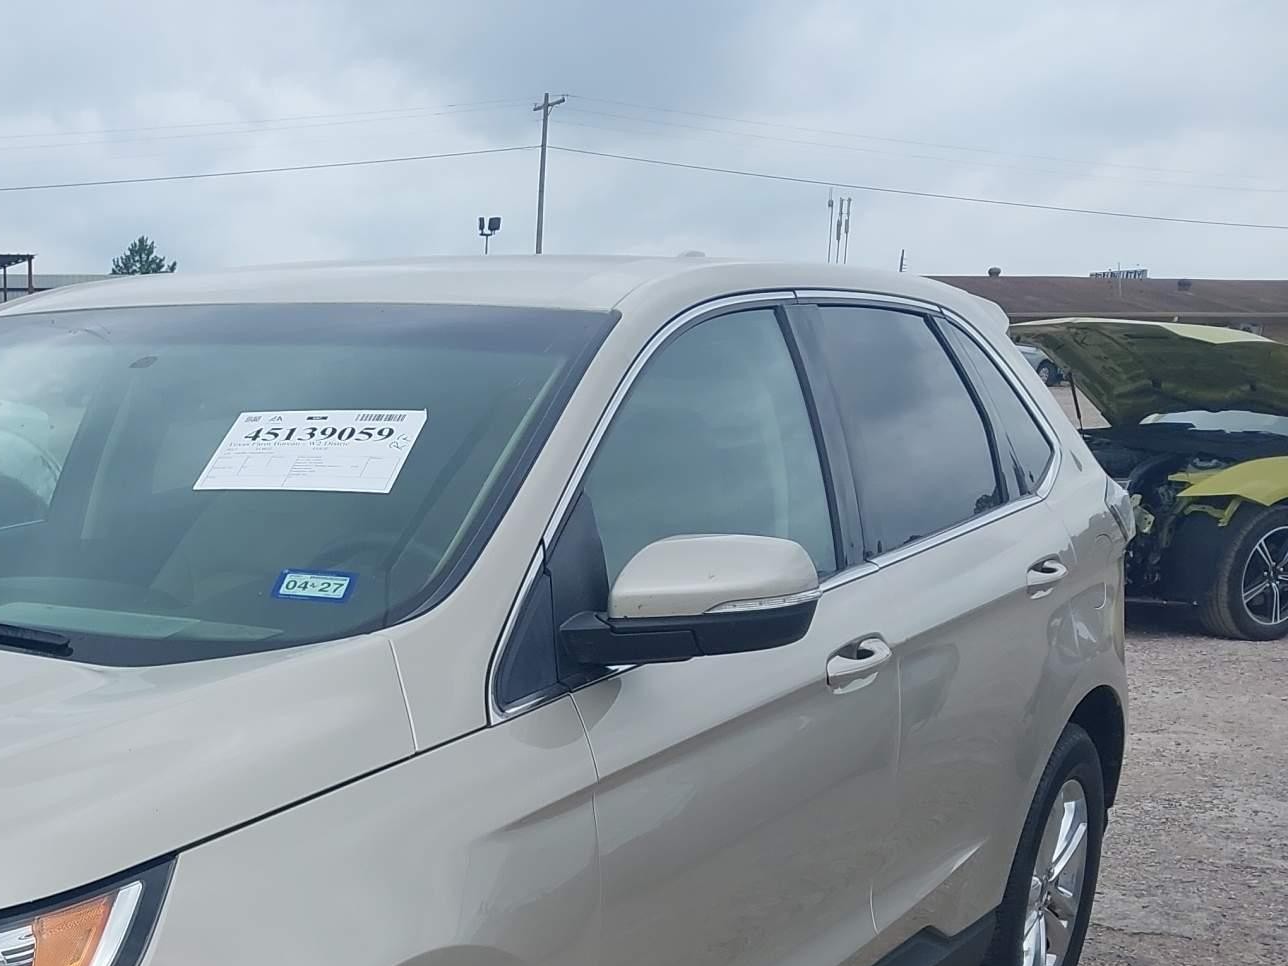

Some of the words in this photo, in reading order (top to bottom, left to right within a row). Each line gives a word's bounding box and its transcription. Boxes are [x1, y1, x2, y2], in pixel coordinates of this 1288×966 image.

[244, 426, 394, 441] 45139059
[285, 580, 309, 591] 04
[318, 582, 344, 593] 27
